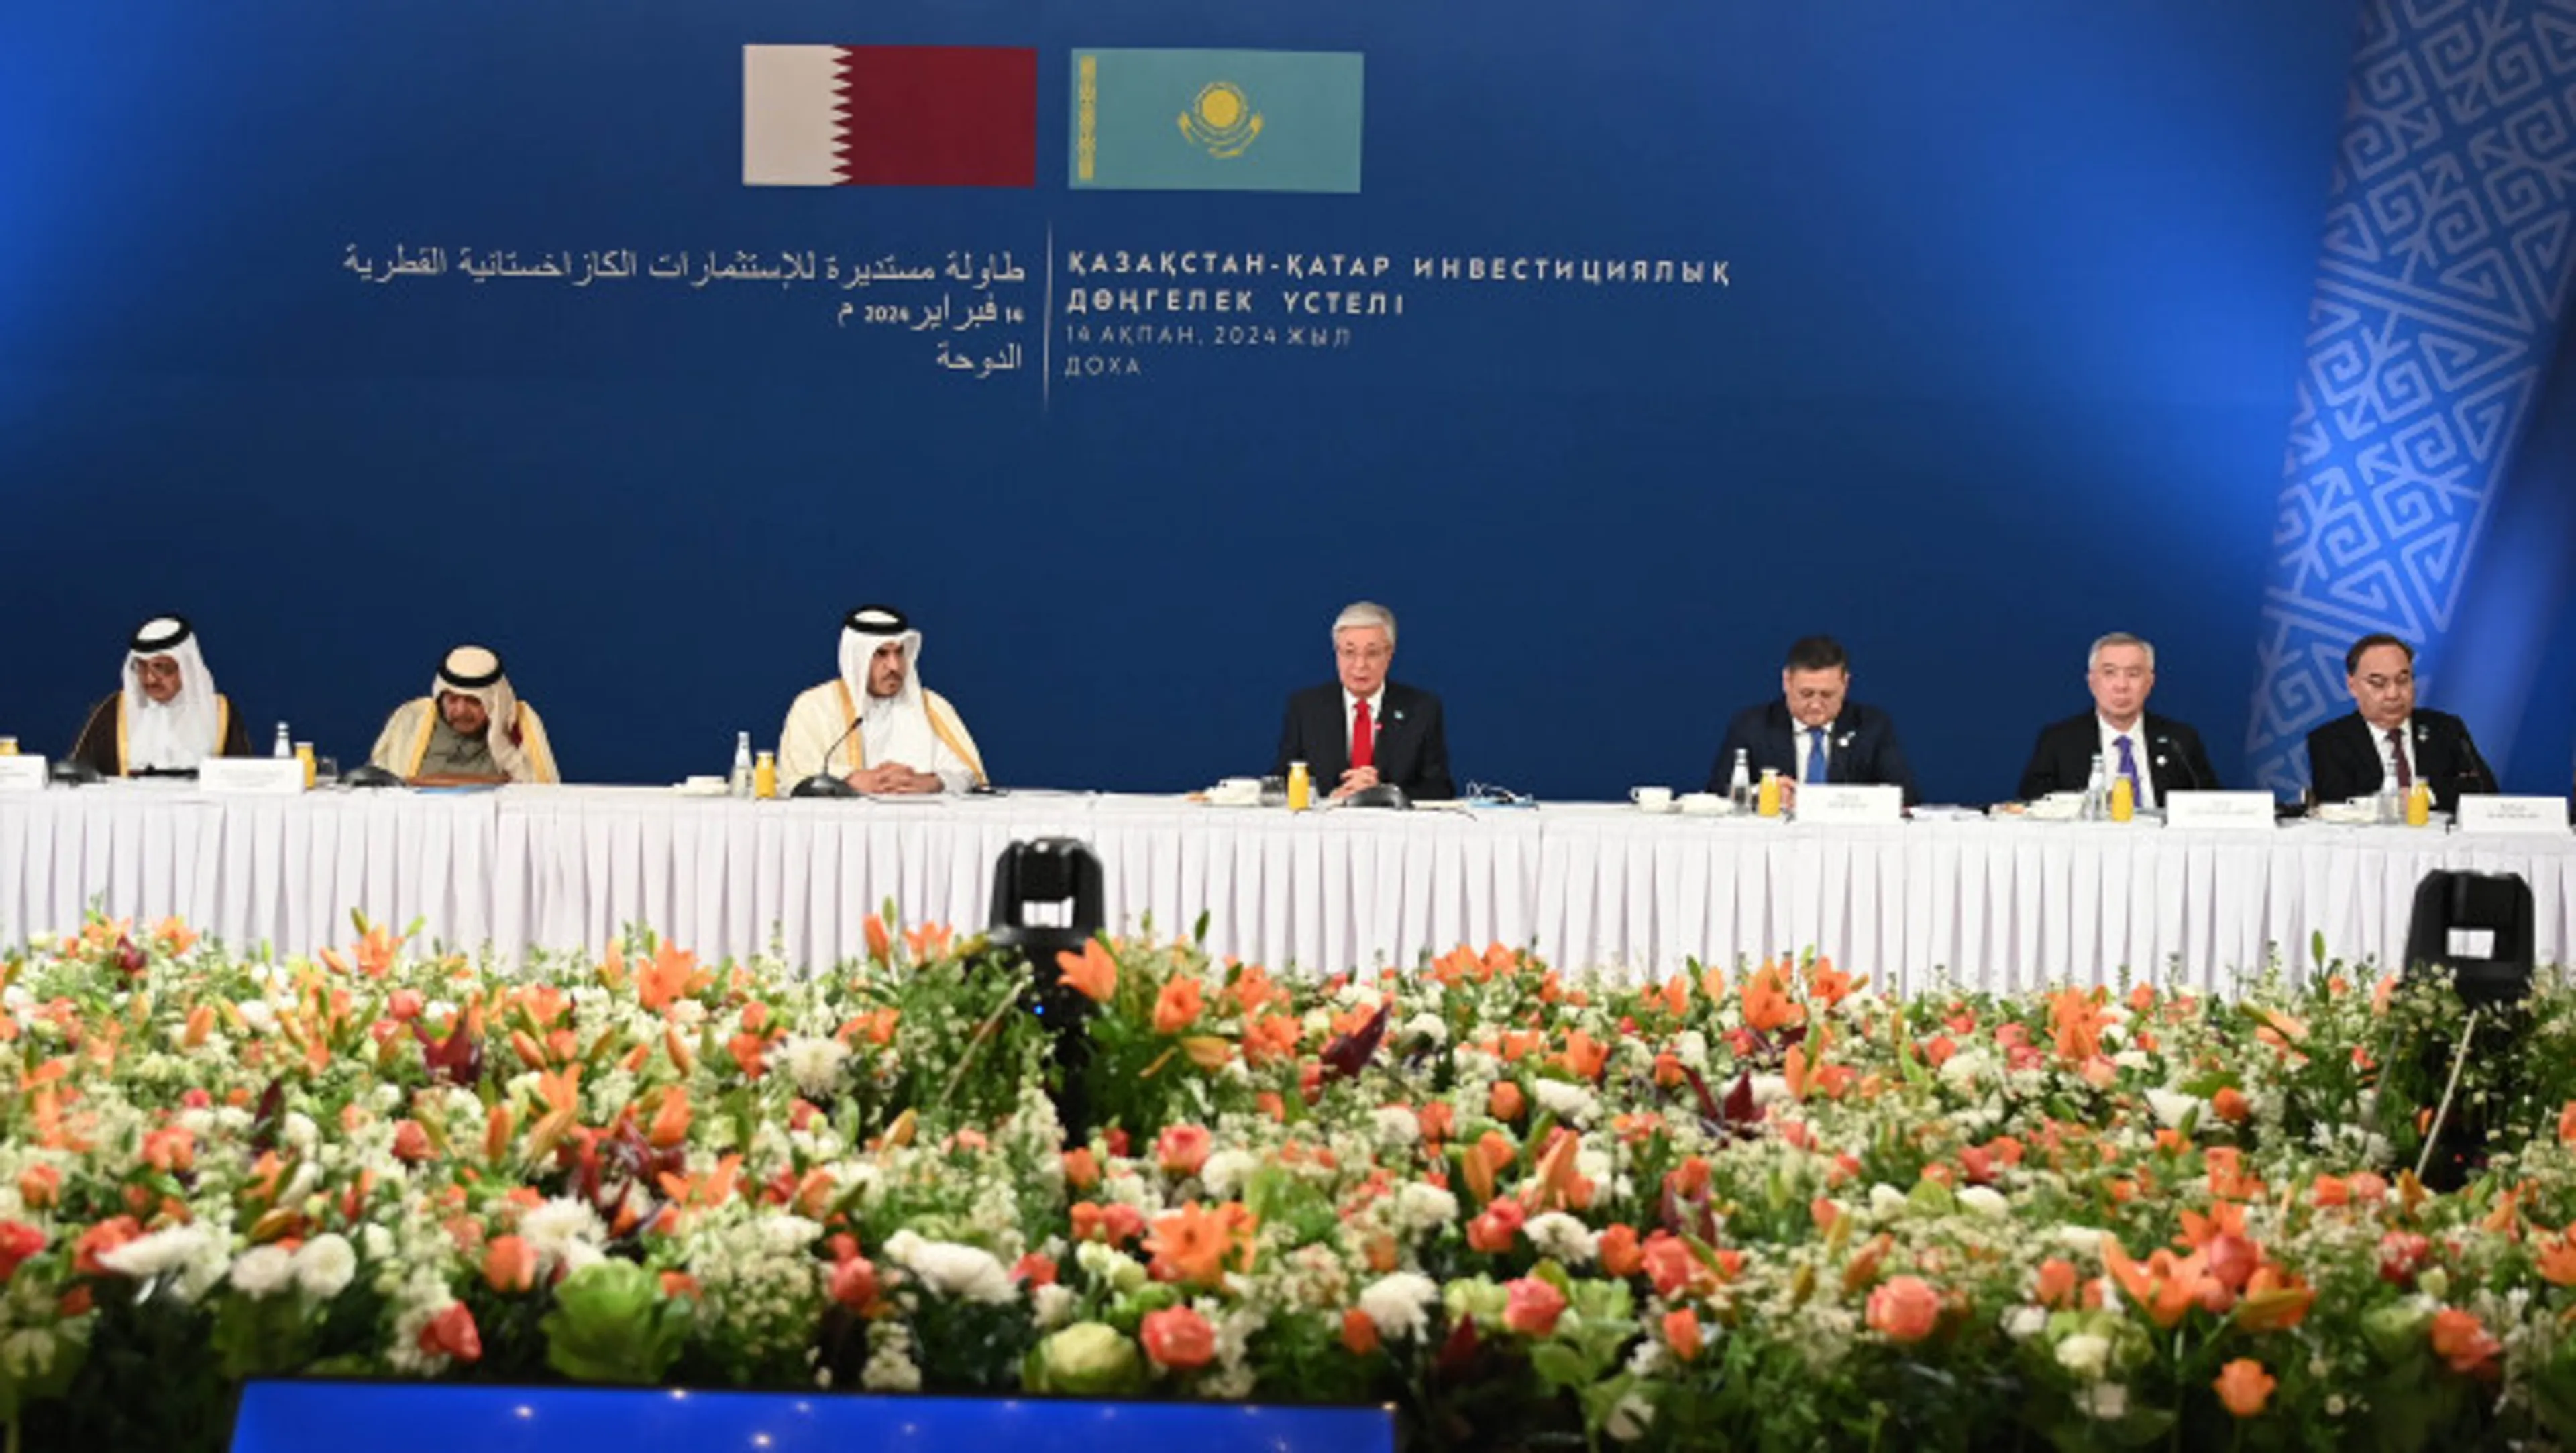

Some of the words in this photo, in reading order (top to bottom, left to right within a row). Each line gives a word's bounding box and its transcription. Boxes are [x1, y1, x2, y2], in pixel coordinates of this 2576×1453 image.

[343, 243, 447, 282] القطرية
[824, 254, 936, 290] مستديرة
[944, 250, 1026, 289] طاولة
[1068, 250, 1390, 279] ҚАЗАҚСТАН-ҚАТАР
[1413, 257, 1729, 286] ИНВЕСТИЦИЯЛЫҚ
[1066, 288, 1252, 315] ДӨҢГЕЛЕК
[1214, 325, 1276, 345] 2024
[1287, 327, 1351, 347] ЖЫЛ
[936, 341, 1022, 378] الدوحة
[1065, 356, 1140, 376] ДОХА
